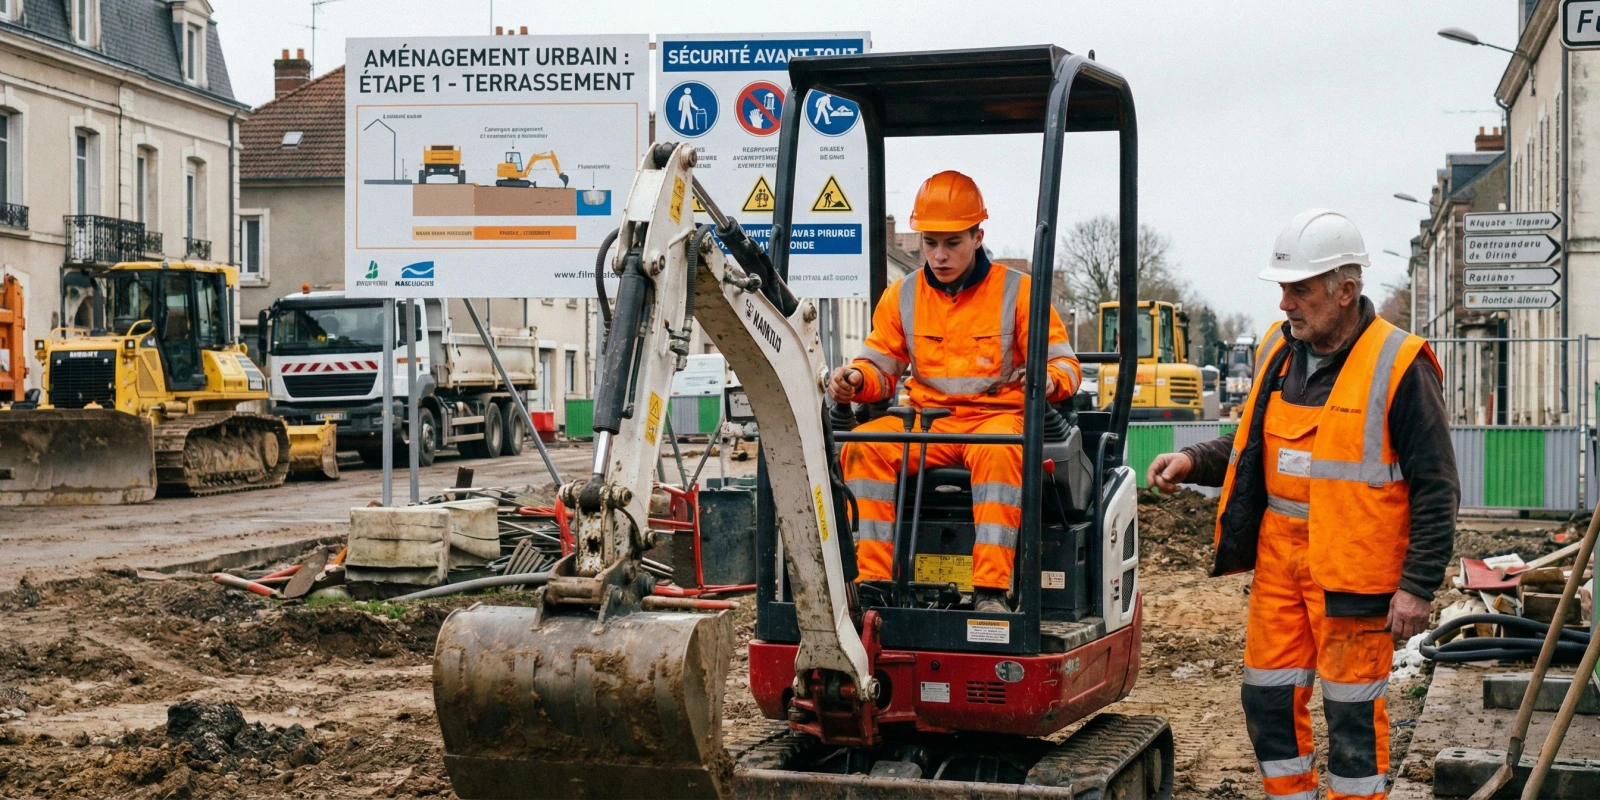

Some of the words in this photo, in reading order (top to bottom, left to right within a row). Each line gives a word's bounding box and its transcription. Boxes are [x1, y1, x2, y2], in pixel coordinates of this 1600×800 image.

[364, 44, 530, 67] AMÉNAGEMENT
[536, 47, 616, 66] URBAIN
[624, 53, 629, 65] :
[668, 44, 750, 64] SÉCURITÉ
[360, 70, 425, 93] ÉTAPE
[432, 75, 440, 92] 1
[462, 72, 635, 92] TERRASSEMENT
